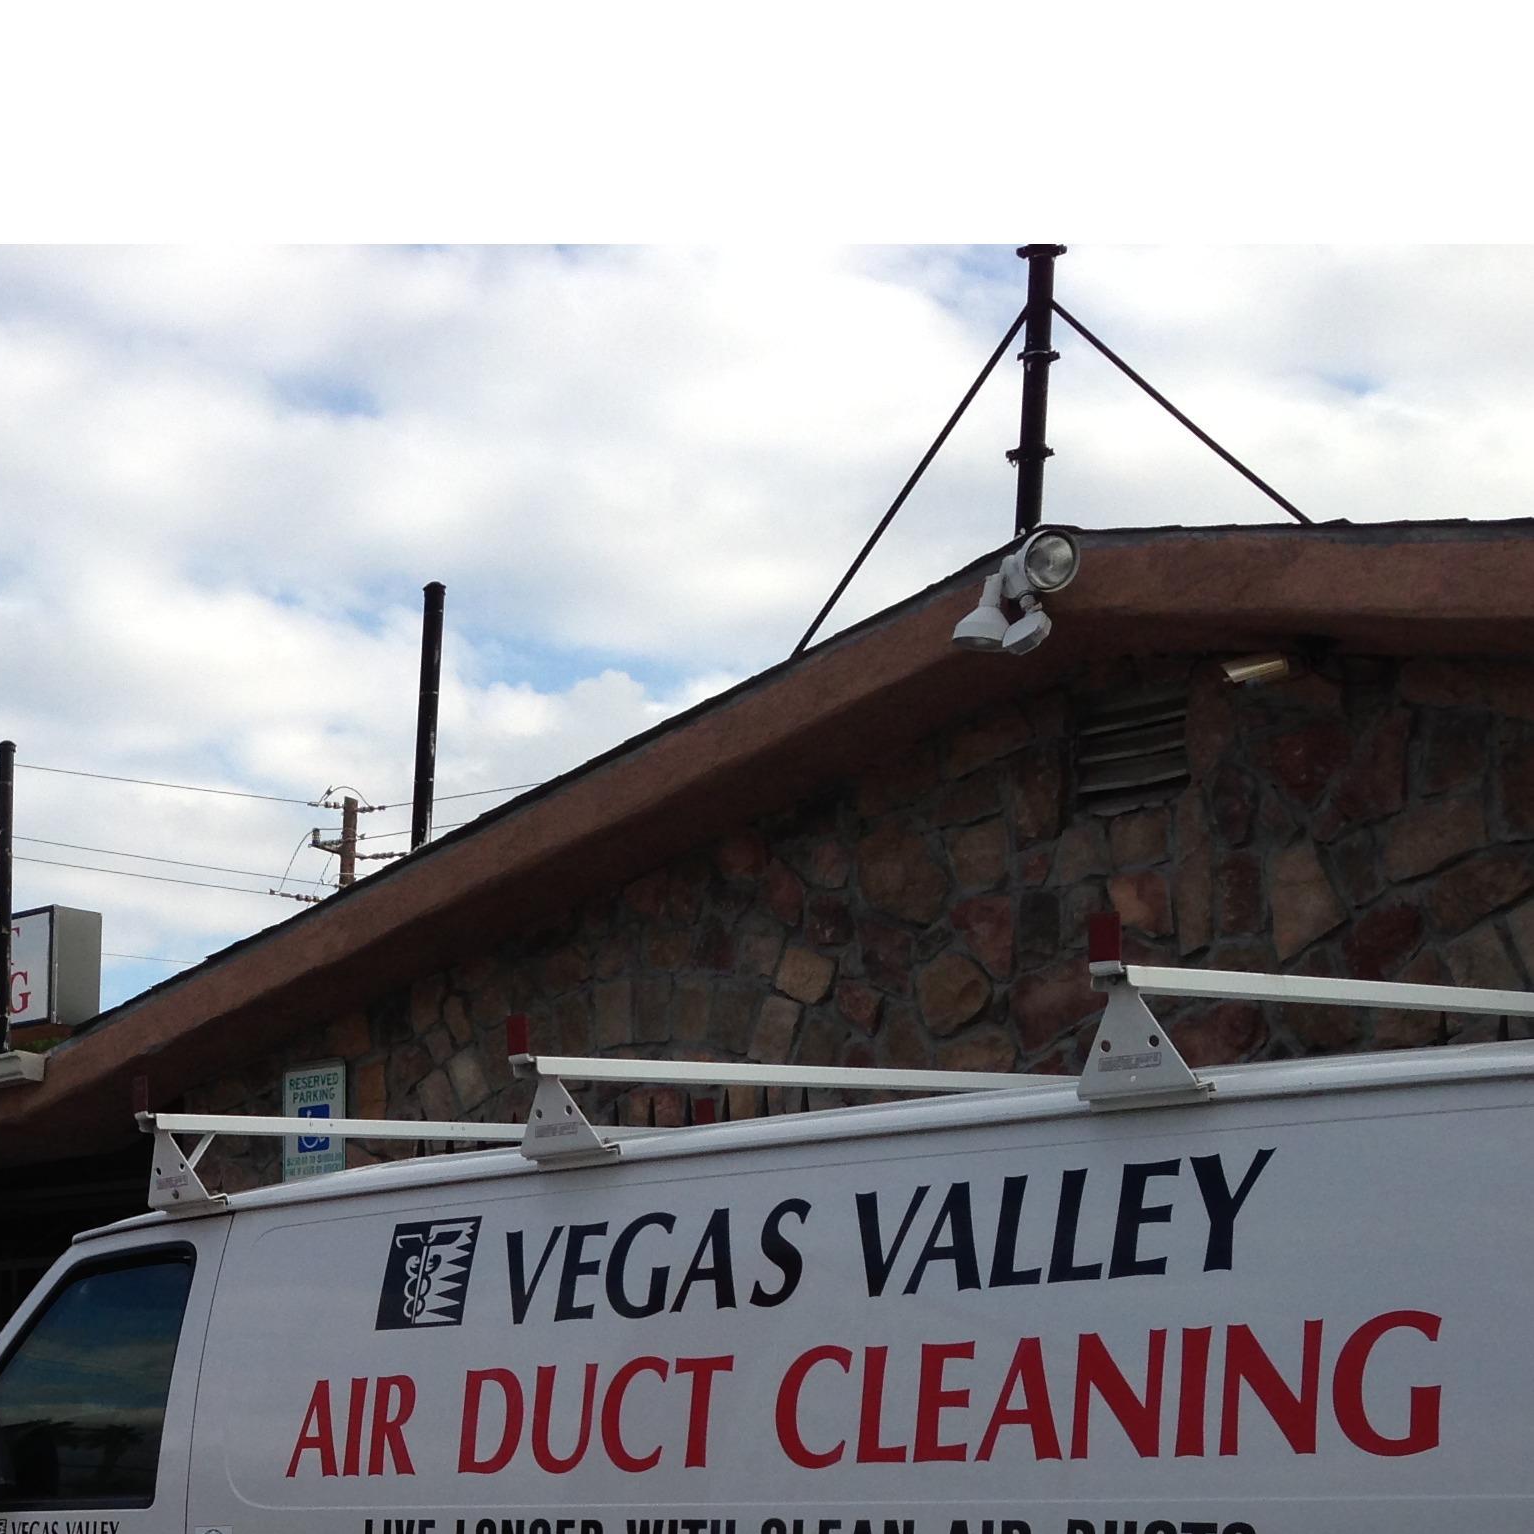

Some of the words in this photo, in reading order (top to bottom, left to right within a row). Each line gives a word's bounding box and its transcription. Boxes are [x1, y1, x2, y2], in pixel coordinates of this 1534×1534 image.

[289, 1072, 339, 1091] RESERVED
[293, 1087, 336, 1104] PARKING
[505, 1197, 812, 1325] VEGAS
[855, 1147, 1277, 1297] VALLEY
[286, 1374, 416, 1478] AIR
[458, 1354, 734, 1475] DUCT
[775, 1310, 1442, 1470] CLEANING
